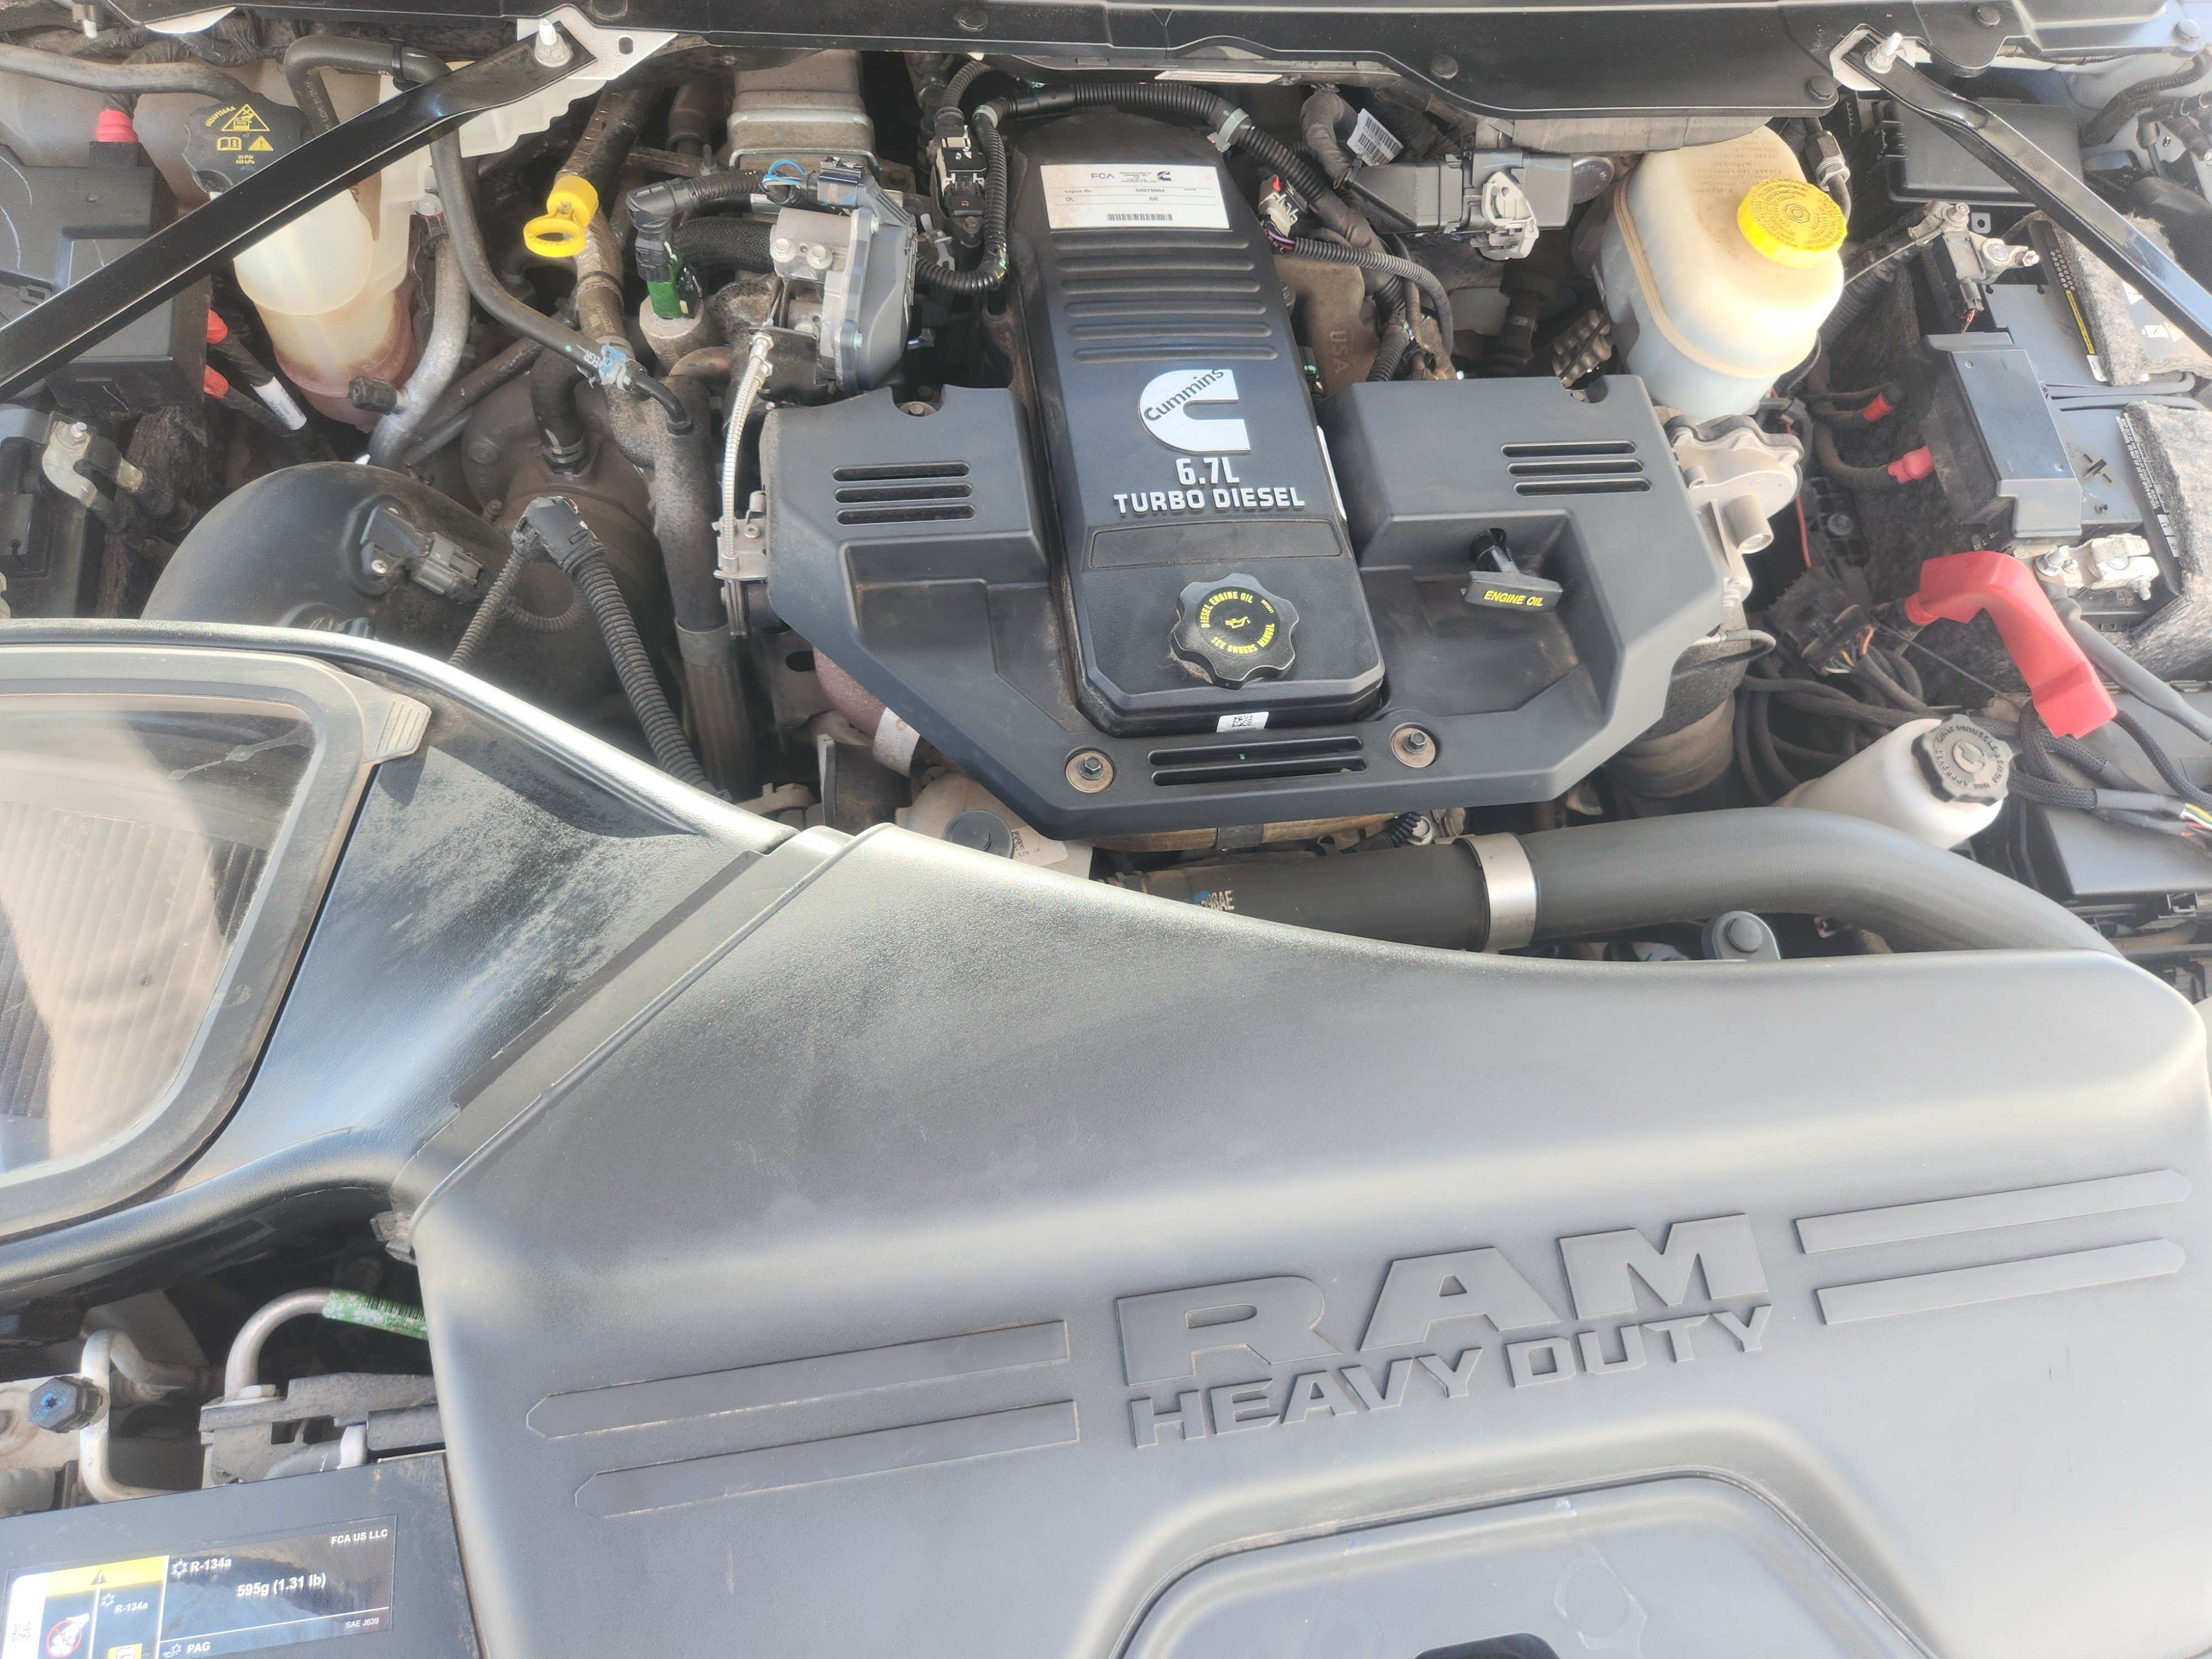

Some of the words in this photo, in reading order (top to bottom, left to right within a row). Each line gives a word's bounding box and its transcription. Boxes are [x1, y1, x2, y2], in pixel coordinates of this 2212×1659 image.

[1144, 369, 1224, 421] Cummins
[1176, 457, 1240, 486] 6.7L
[1114, 489, 1206, 514] TURBO
[1213, 487, 1306, 508] DIESEL
[1200, 604, 1213, 628] DIESEL
[1209, 591, 1238, 606] ENGINE
[1240, 593, 1253, 603] OIL
[1484, 590, 1526, 604] ENGINE
[1526, 596, 1544, 607] OIL
[1211, 637, 1227, 649] SEE
[1227, 644, 1258, 654] OWNERS
[1257, 623, 1275, 648] MANUAL
[1115, 1213, 1769, 1386] RAM
[1129, 1347, 1482, 1448] HEAVY
[1505, 1304, 1772, 1389] DUTY
[331, 1535, 351, 1545] FCA
[353, 1532, 367, 1542] US
[369, 1528, 388, 1540] LLC
[190, 1557, 232, 1572] R-134a
[237, 1580, 269, 1597] 595g
[273, 1576, 305, 1595] (1.31
[309, 1573, 327, 1588] lb)
[114, 1601, 148, 1614] R-134a
[346, 1620, 362, 1629] SAE
[363, 1617, 379, 1627] J639
[187, 1641, 211, 1653] PAG
